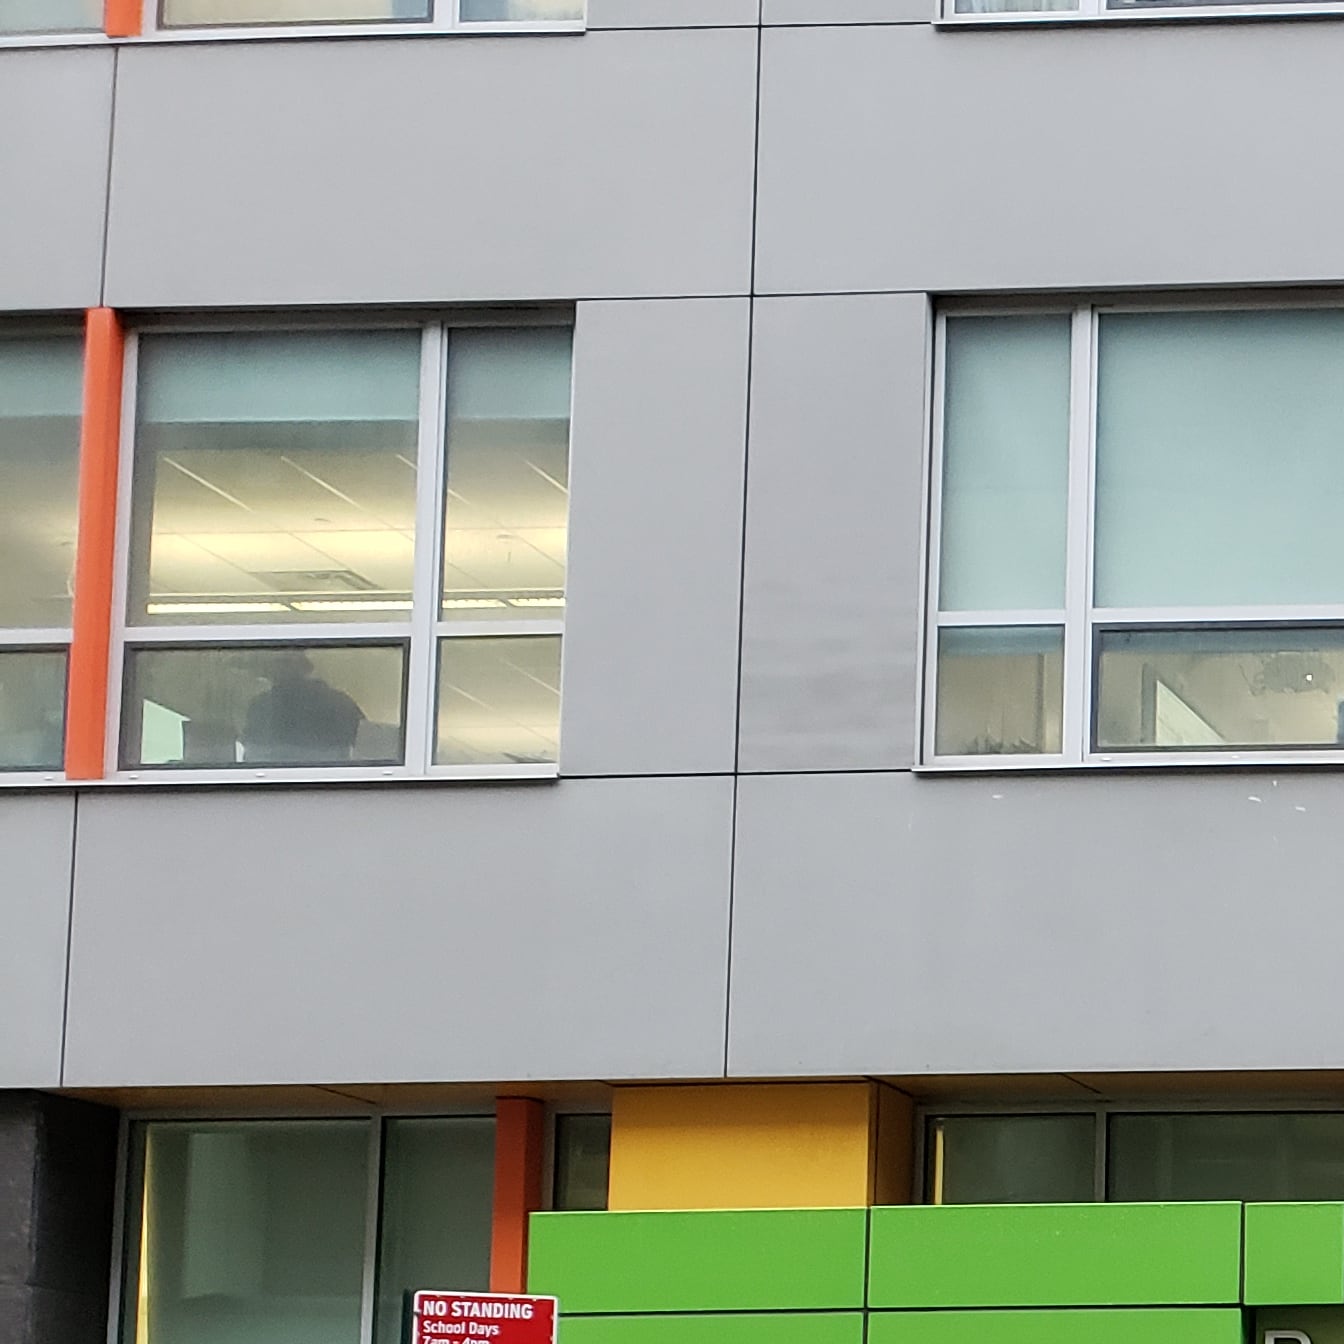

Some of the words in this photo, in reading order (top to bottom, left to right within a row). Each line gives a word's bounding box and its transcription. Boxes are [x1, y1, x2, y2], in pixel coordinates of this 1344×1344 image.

[423, 1301, 447, 1316] NO
[451, 1302, 533, 1319] STANDING
[423, 1320, 466, 1334] School
[469, 1322, 499, 1338] Days
